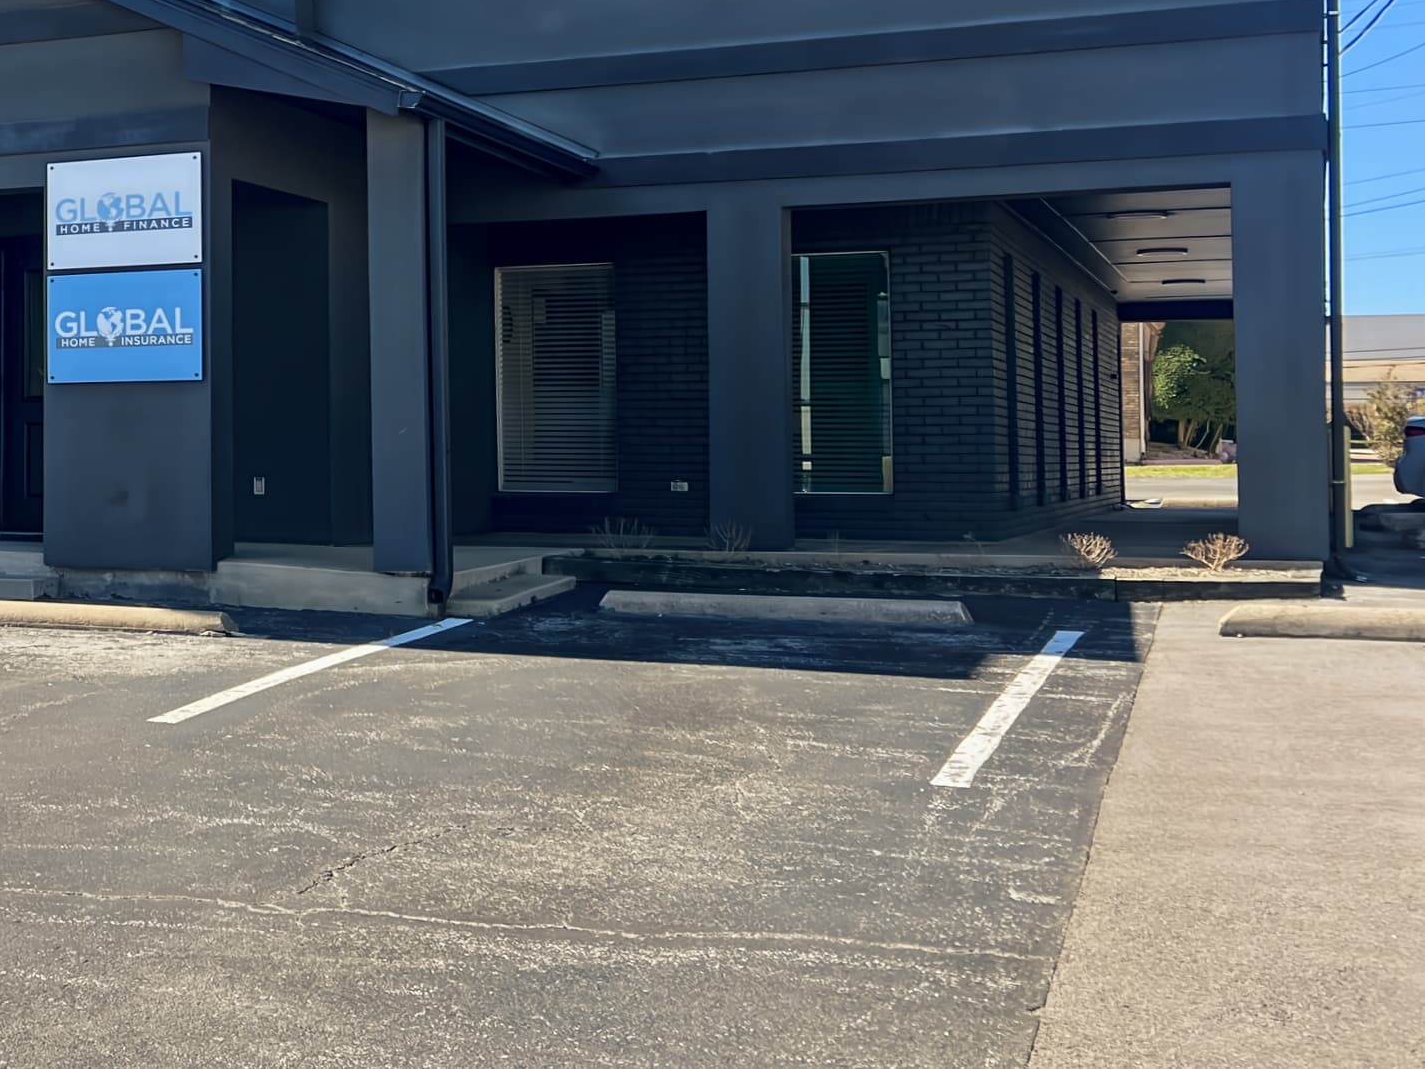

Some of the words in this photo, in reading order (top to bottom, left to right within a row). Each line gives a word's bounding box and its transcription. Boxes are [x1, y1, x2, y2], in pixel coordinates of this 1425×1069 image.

[55, 191, 193, 223] GLOBAL
[60, 224, 100, 234] HOME
[123, 218, 190, 230] FINANCE
[54, 306, 194, 338] GLOBAL
[61, 337, 96, 347] HOME
[121, 334, 192, 346] INSURANCE
